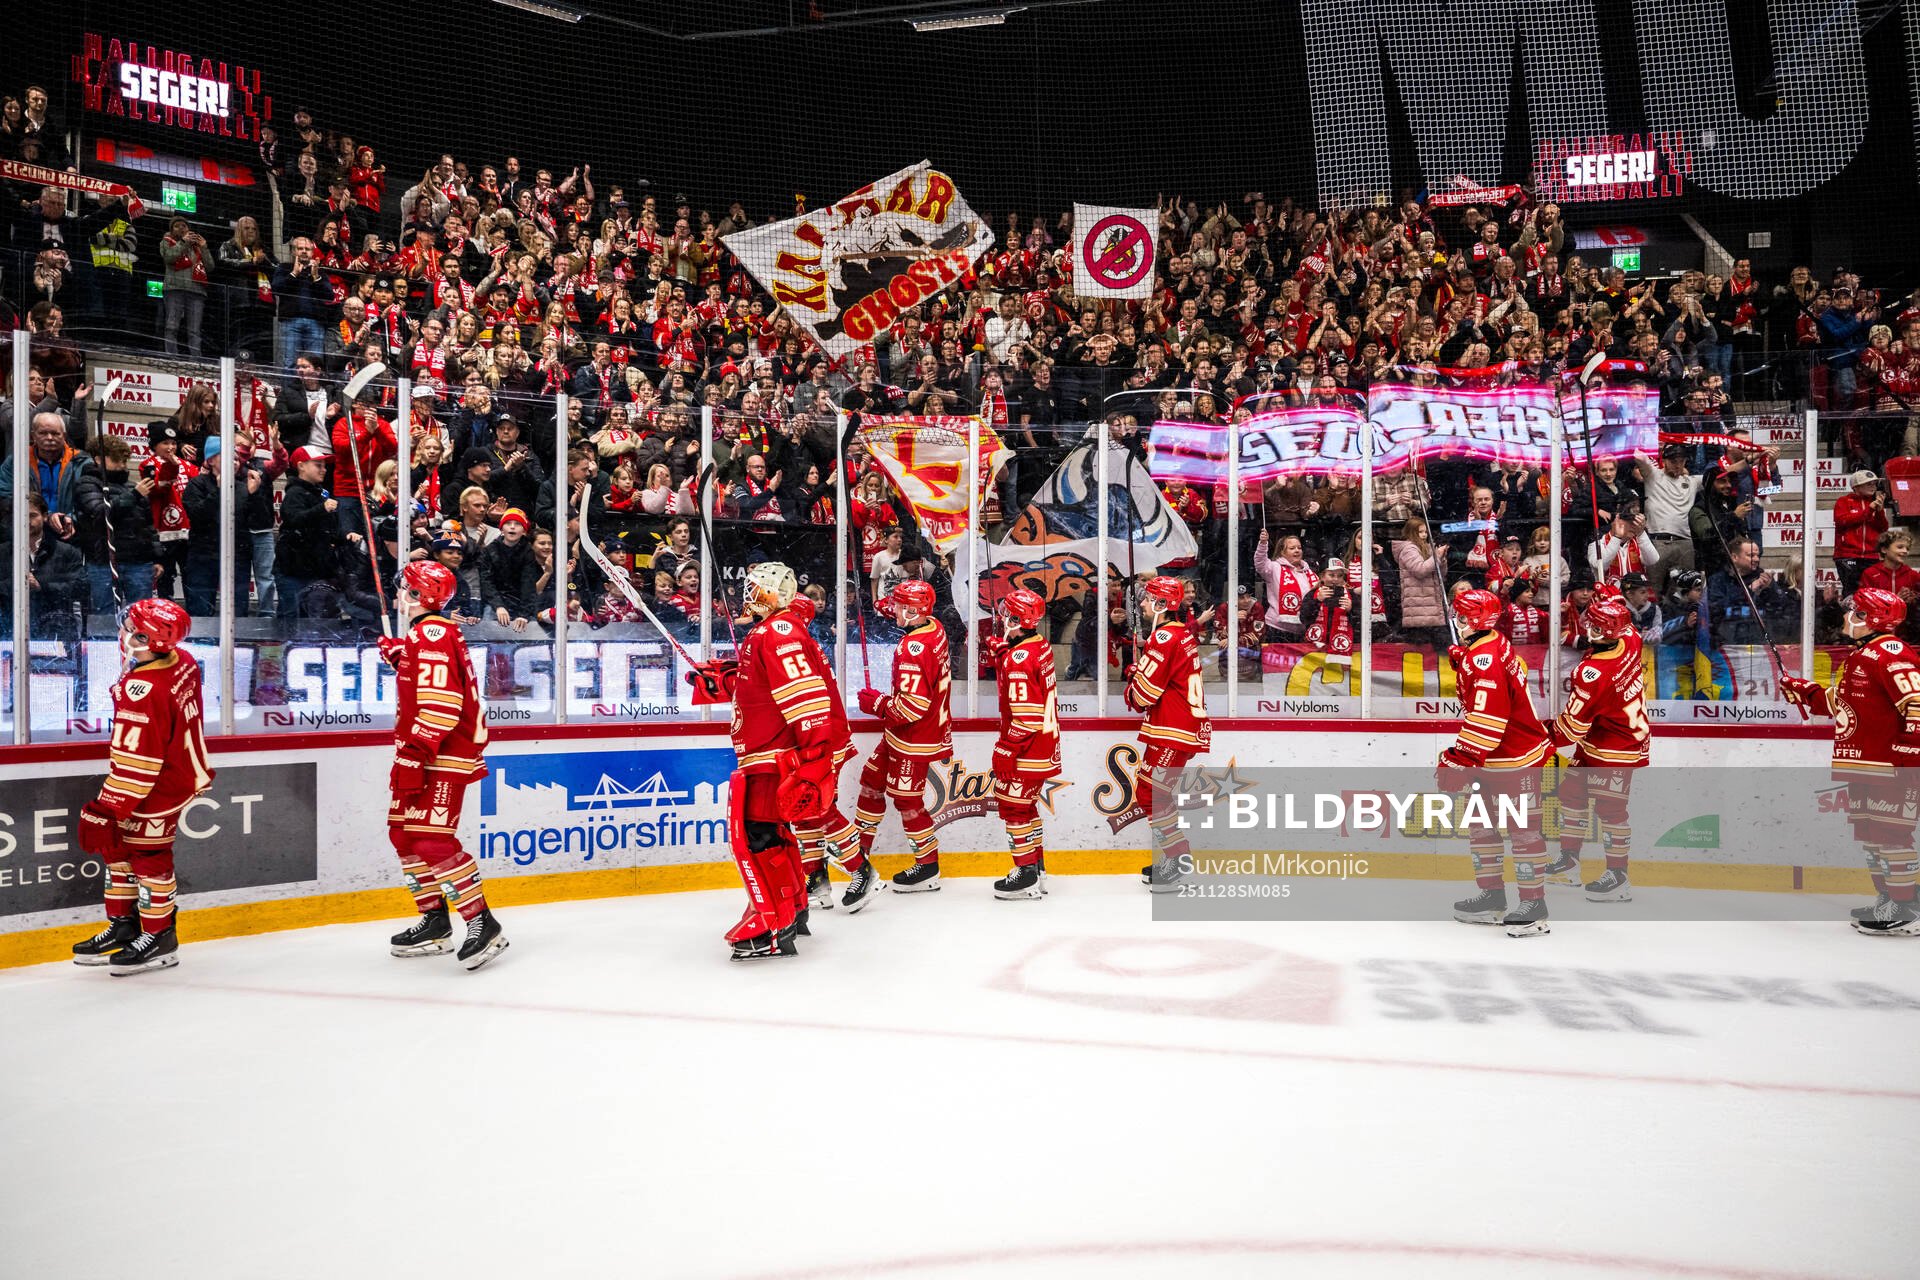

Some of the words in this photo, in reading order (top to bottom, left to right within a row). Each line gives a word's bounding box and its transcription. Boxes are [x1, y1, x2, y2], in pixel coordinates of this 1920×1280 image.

[120, 62, 230, 118] SEGER!
[1300, 0, 1920, 212] MU
[1566, 150, 1656, 187] SEGER!
[842, 247, 970, 341] GHOSTS
[106, 369, 151, 384] MAXI
[1770, 429, 1802, 441] MAX
[1793, 460, 1832, 471] MXI
[1767, 511, 1803, 524] MAX
[1781, 529, 1823, 542] MAI
[417, 662, 449, 688] 20
[782, 653, 812, 679] 65
[1137, 654, 1159, 679] 90
[900, 673, 922, 693] 27
[1009, 682, 1028, 702] 43
[1743, 679, 1770, 697] 21
[1893, 671, 1920, 695] 68
[1283, 700, 1340, 716] Nybloms
[1473, 690, 1488, 711] 9
[299, 711, 372, 730] Nybloms
[484, 706, 532, 721] ybloms
[620, 703, 680, 719] Nybloms
[1723, 705, 1787, 722] Nybloms
[111, 722, 142, 751] 14
[947, 804, 982, 819] STRIPES
[1116, 810, 1134, 826] AND
[0, 860, 101, 888] ELECO
[742, 859, 765, 904] BAUER
[1370, 987, 1702, 1037] SPEL
